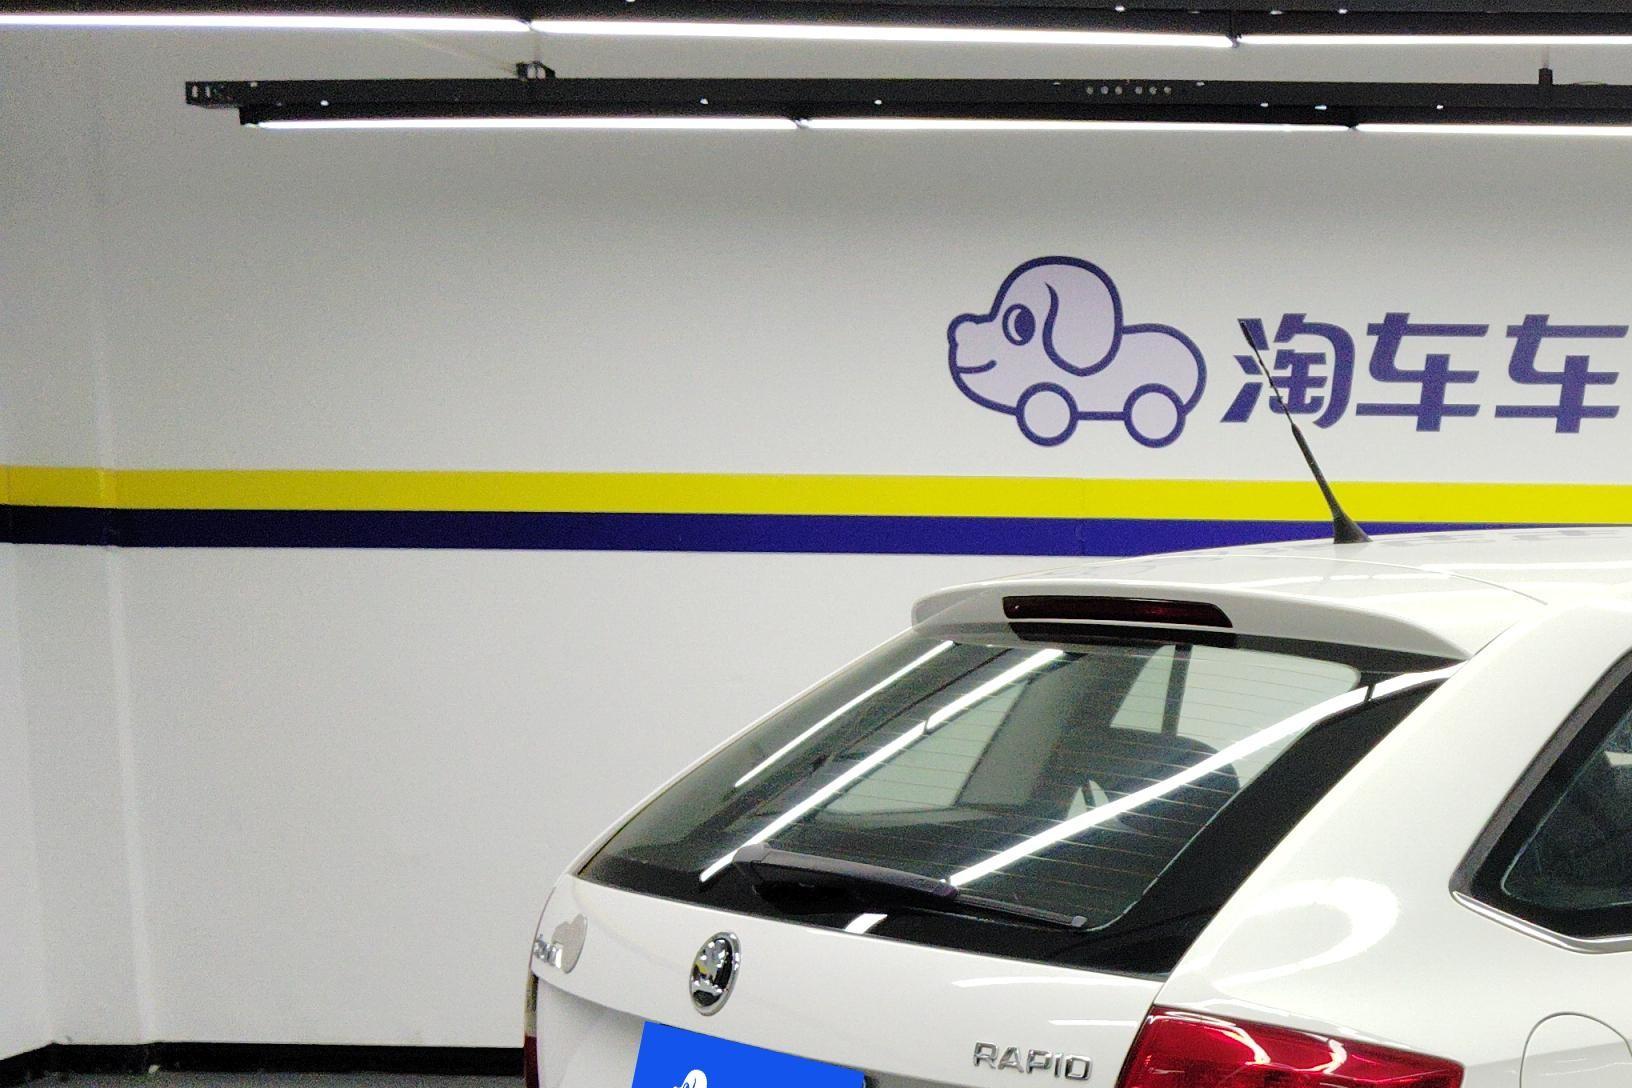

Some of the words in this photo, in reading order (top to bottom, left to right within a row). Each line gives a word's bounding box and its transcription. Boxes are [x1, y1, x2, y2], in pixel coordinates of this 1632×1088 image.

[1220, 312, 1630, 433] 淘车车
[973, 1041, 1093, 1081] RAPID
